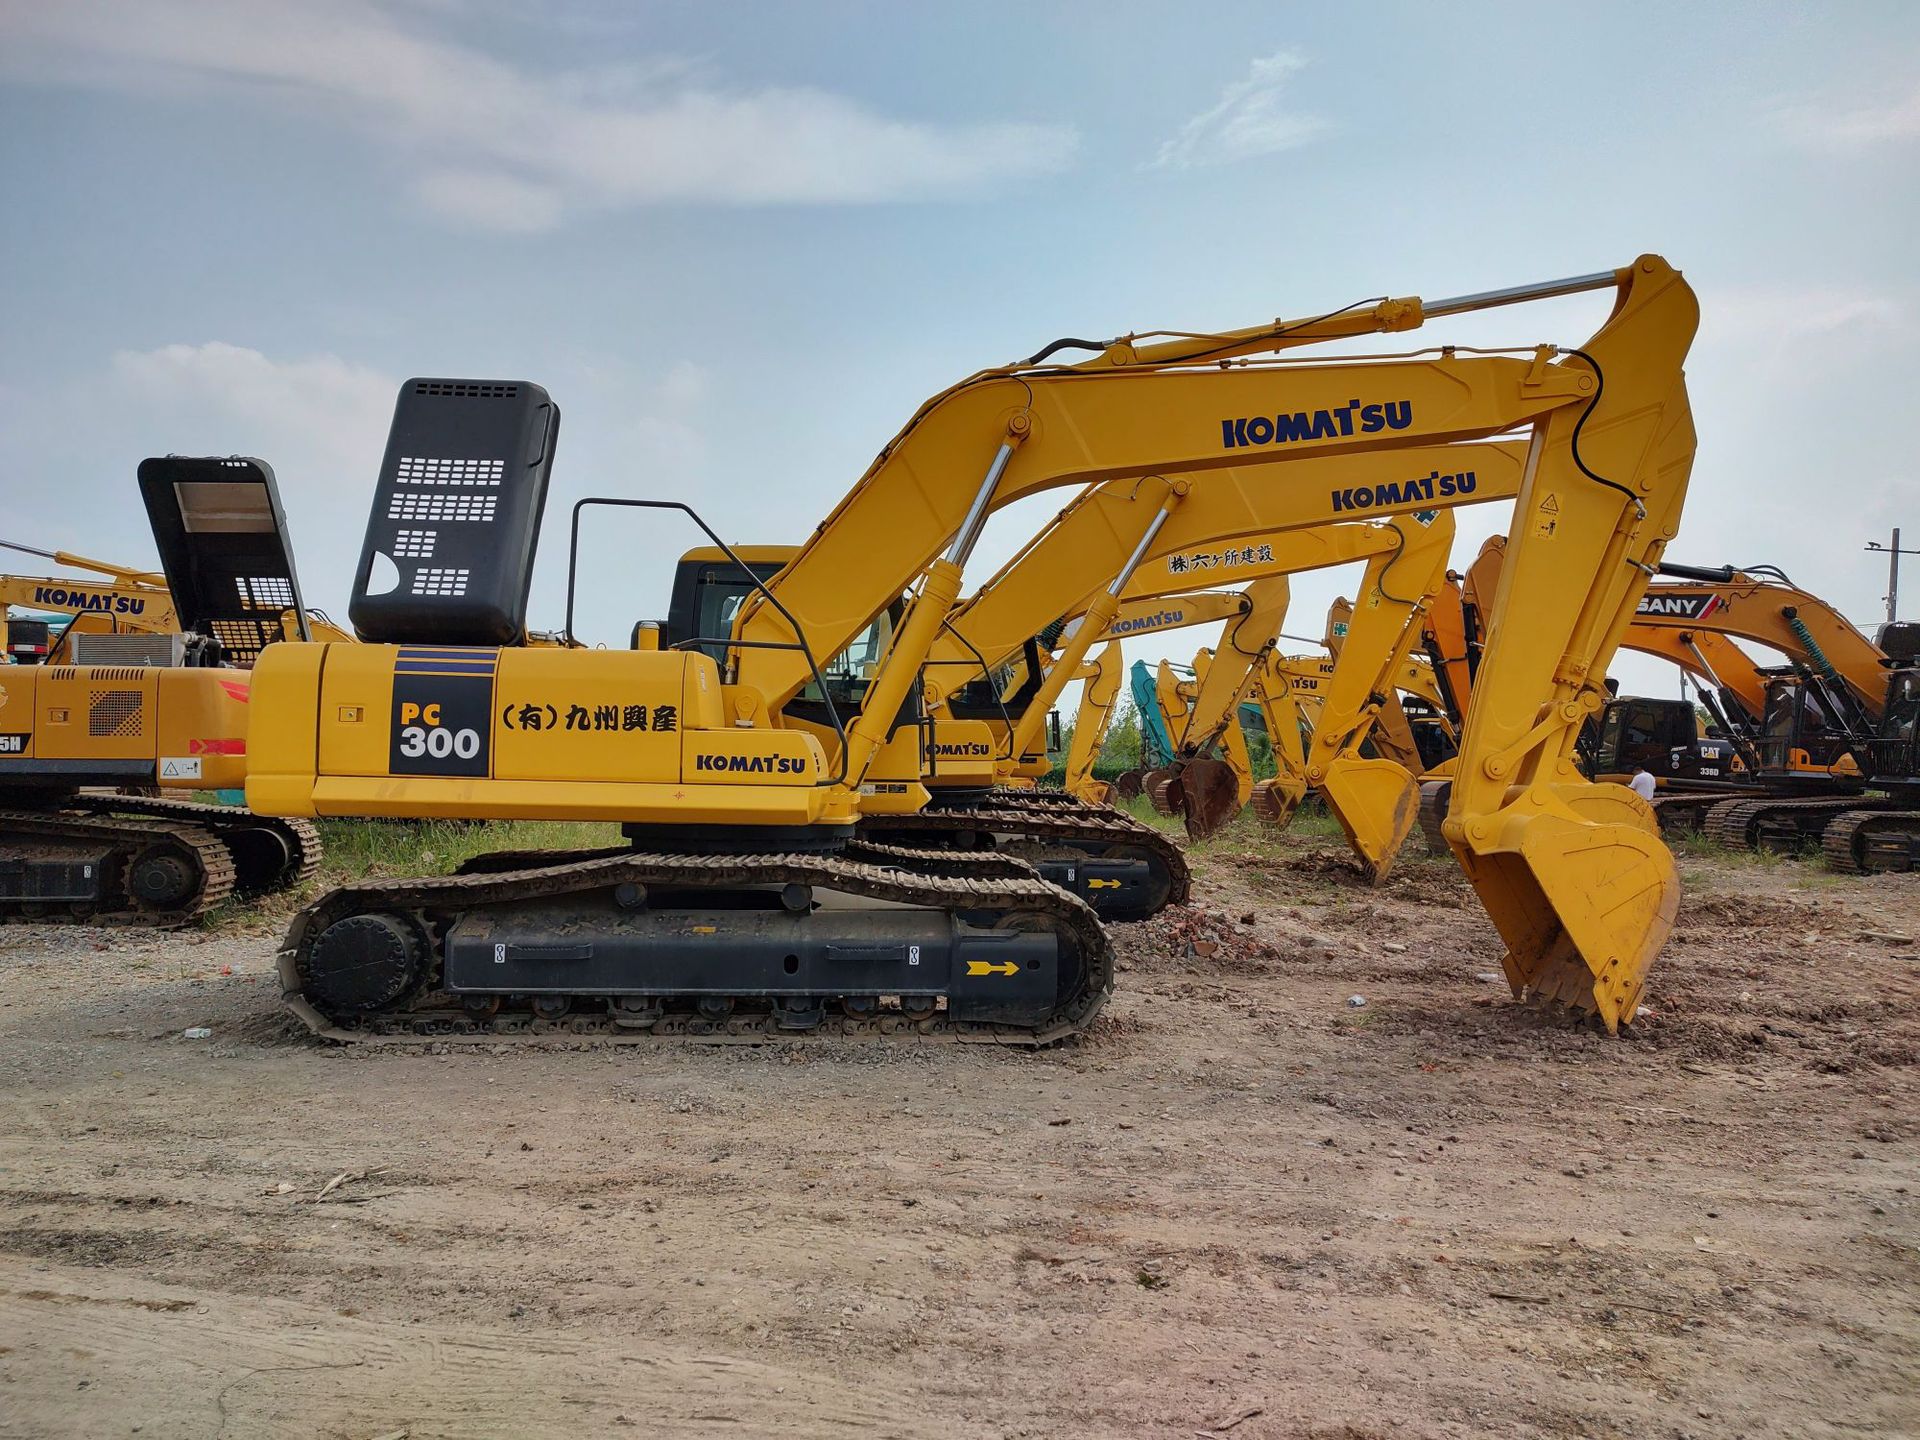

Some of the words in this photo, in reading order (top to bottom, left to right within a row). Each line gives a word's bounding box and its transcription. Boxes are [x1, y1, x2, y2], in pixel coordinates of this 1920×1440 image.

[1221, 399, 1412, 448] KOMATSU
[1331, 471, 1477, 512] KOMATSU
[35, 587, 145, 614] KOMATSU
[1636, 597, 1697, 614] SANY
[1110, 610, 1184, 634] KOMATSU
[401, 703, 441, 726] PC
[400, 726, 480, 759] 300
[1700, 746, 1720, 759] CAT
[696, 754, 806, 774] KOMATSU
